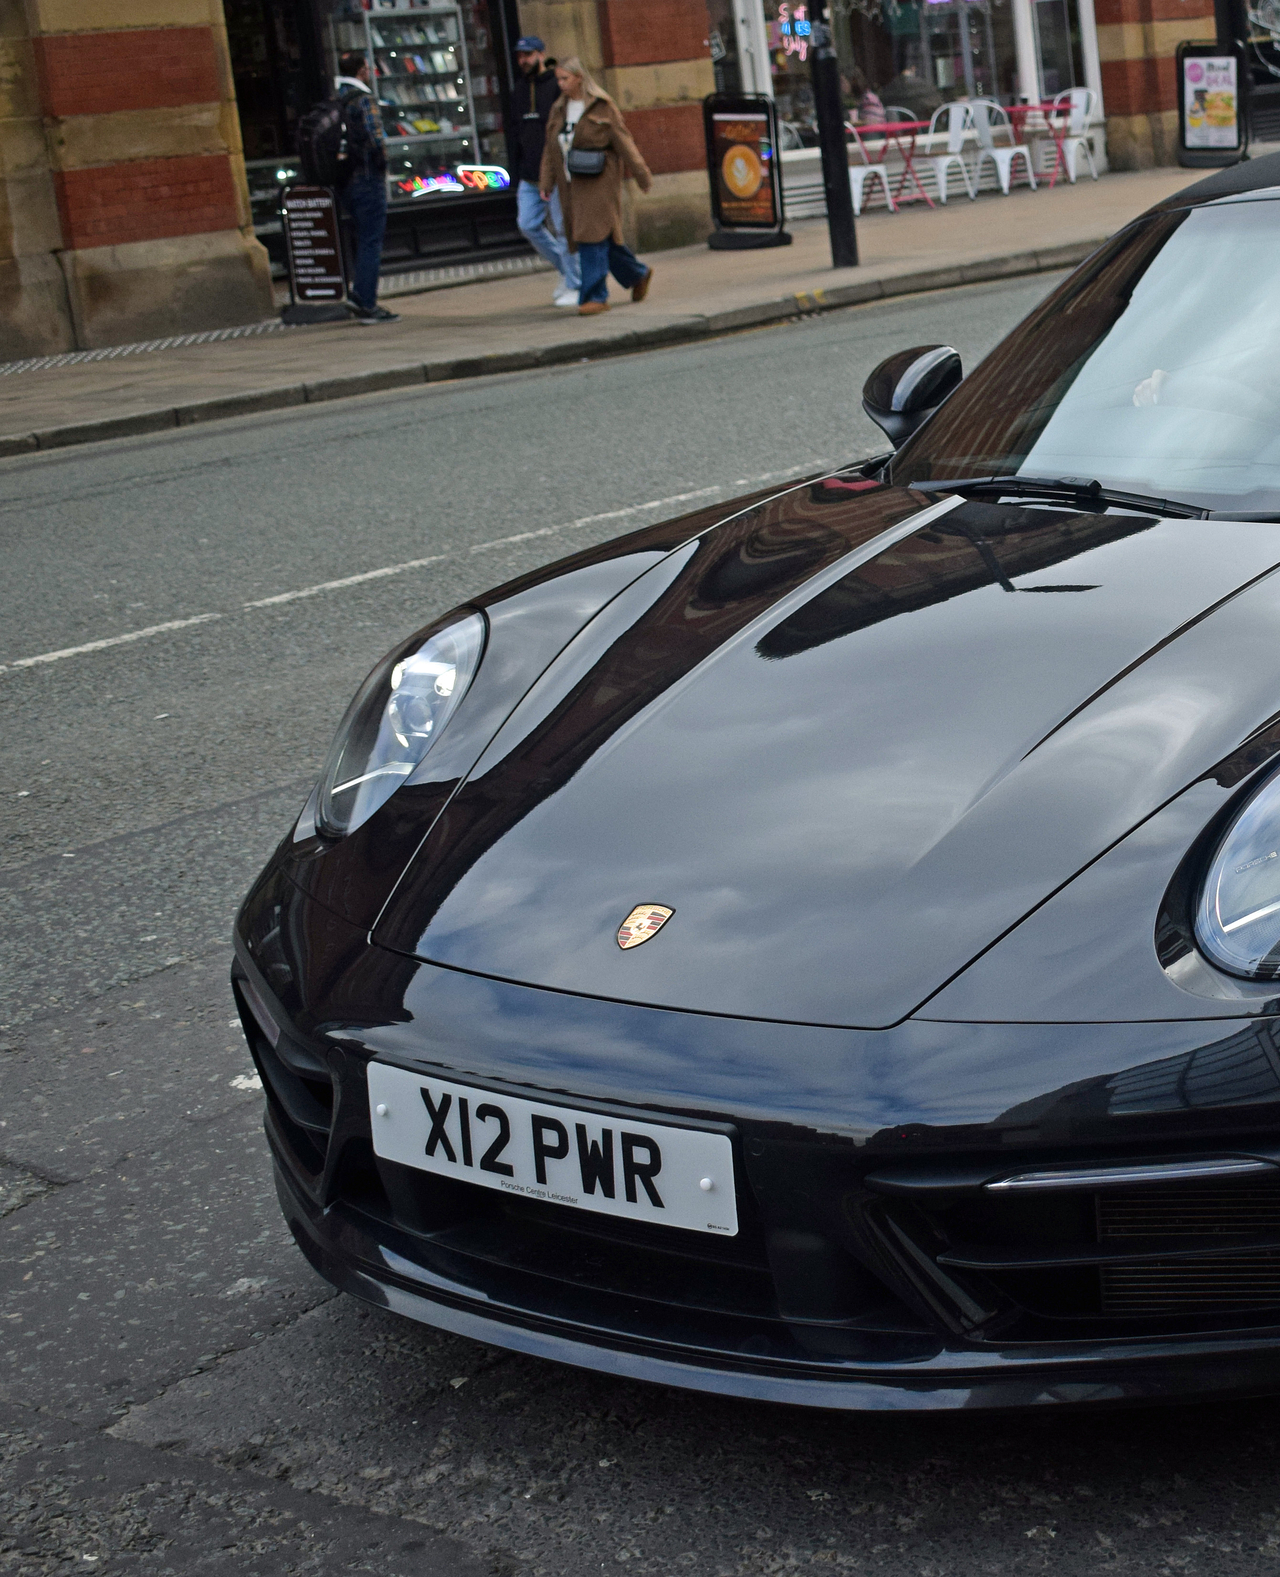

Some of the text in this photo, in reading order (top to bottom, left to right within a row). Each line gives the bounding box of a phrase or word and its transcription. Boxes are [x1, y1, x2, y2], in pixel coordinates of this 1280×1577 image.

[419, 1086, 666, 1209] X12 PWR
[501, 1180, 579, 1205] Porsche Centre Leicester
